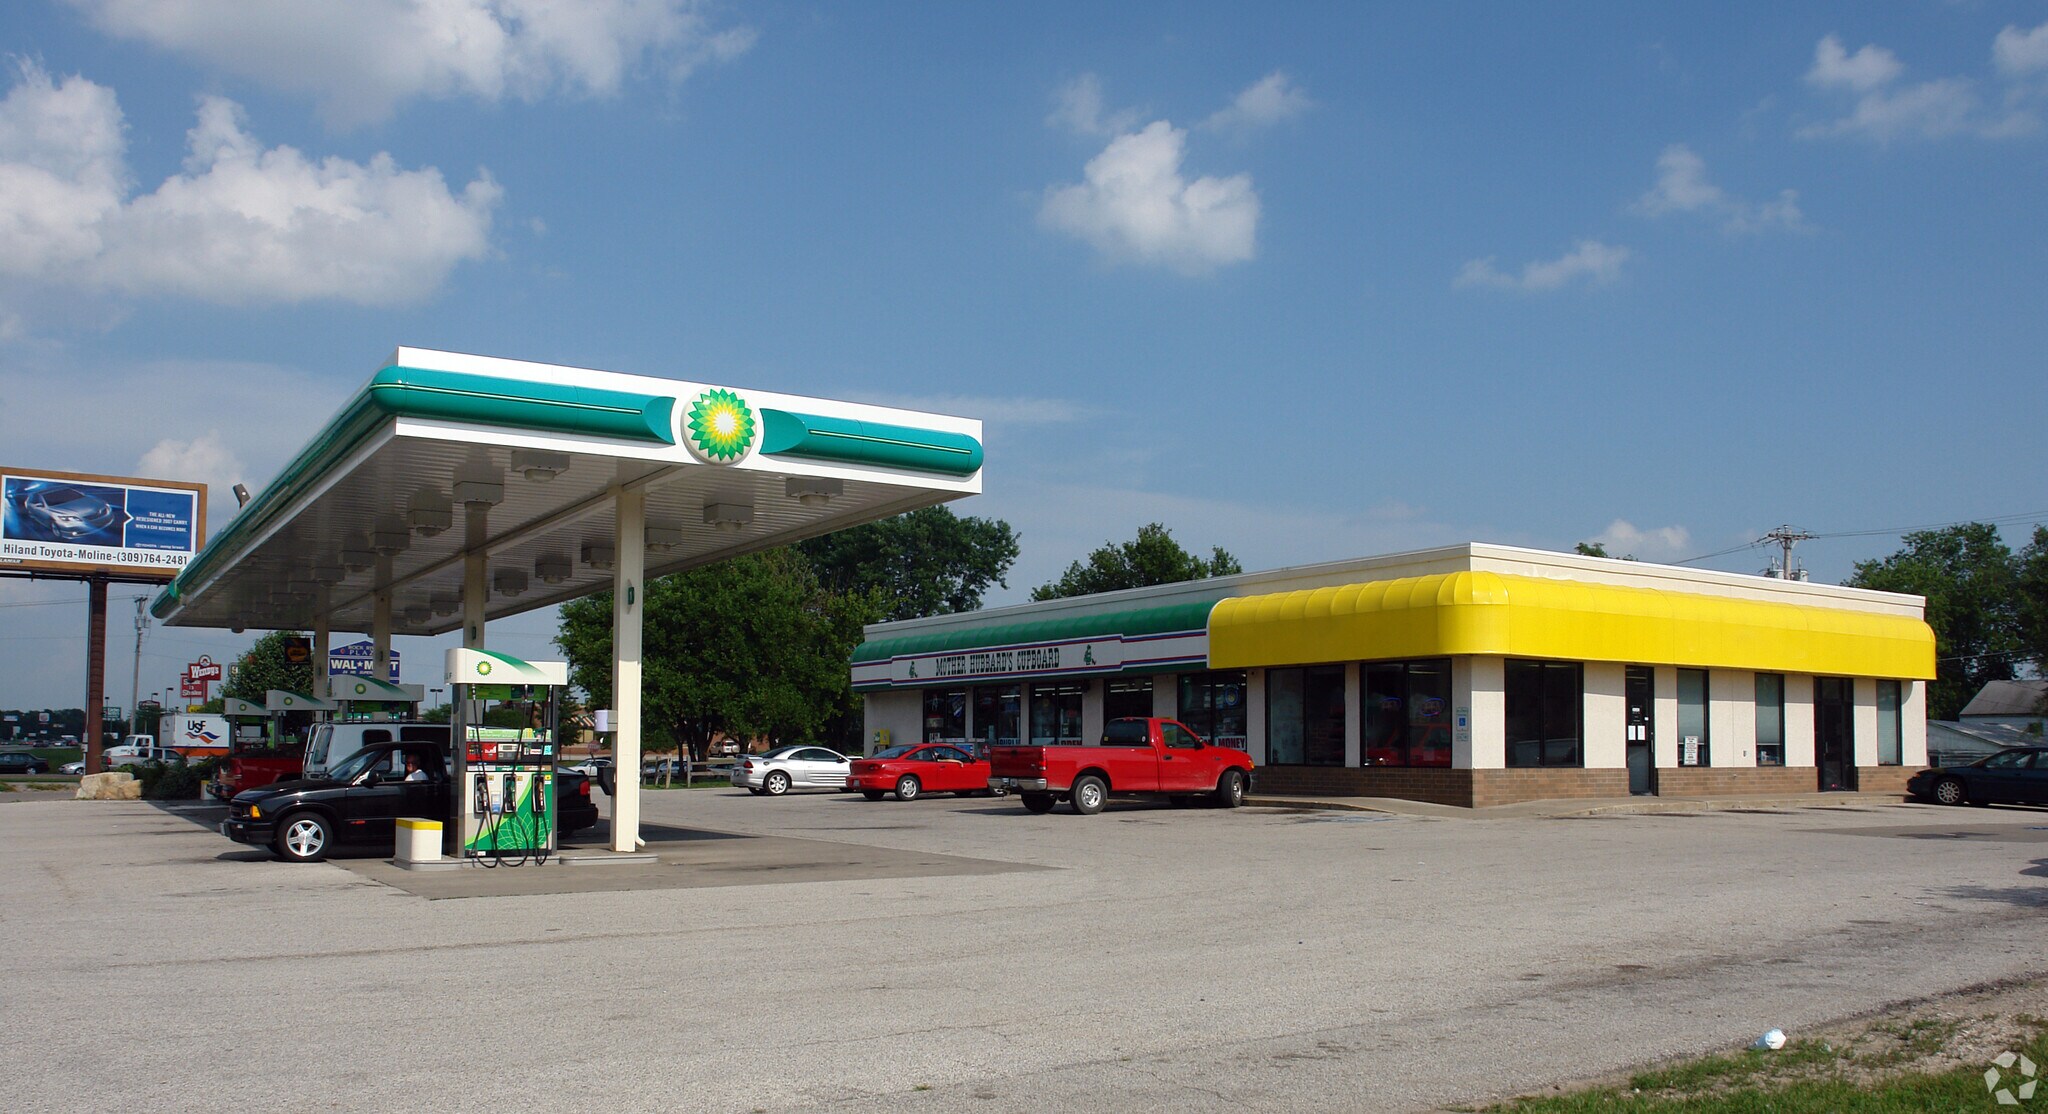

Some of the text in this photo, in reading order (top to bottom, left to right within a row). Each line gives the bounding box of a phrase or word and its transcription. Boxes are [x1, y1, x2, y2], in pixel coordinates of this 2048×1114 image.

[3, 543, 37, 556] Hiland
[936, 647, 1060, 676] MOTHER HUBBARD'S CUPBOARD
[187, 720, 207, 734] USF
[1218, 737, 1246, 749] MONEY
